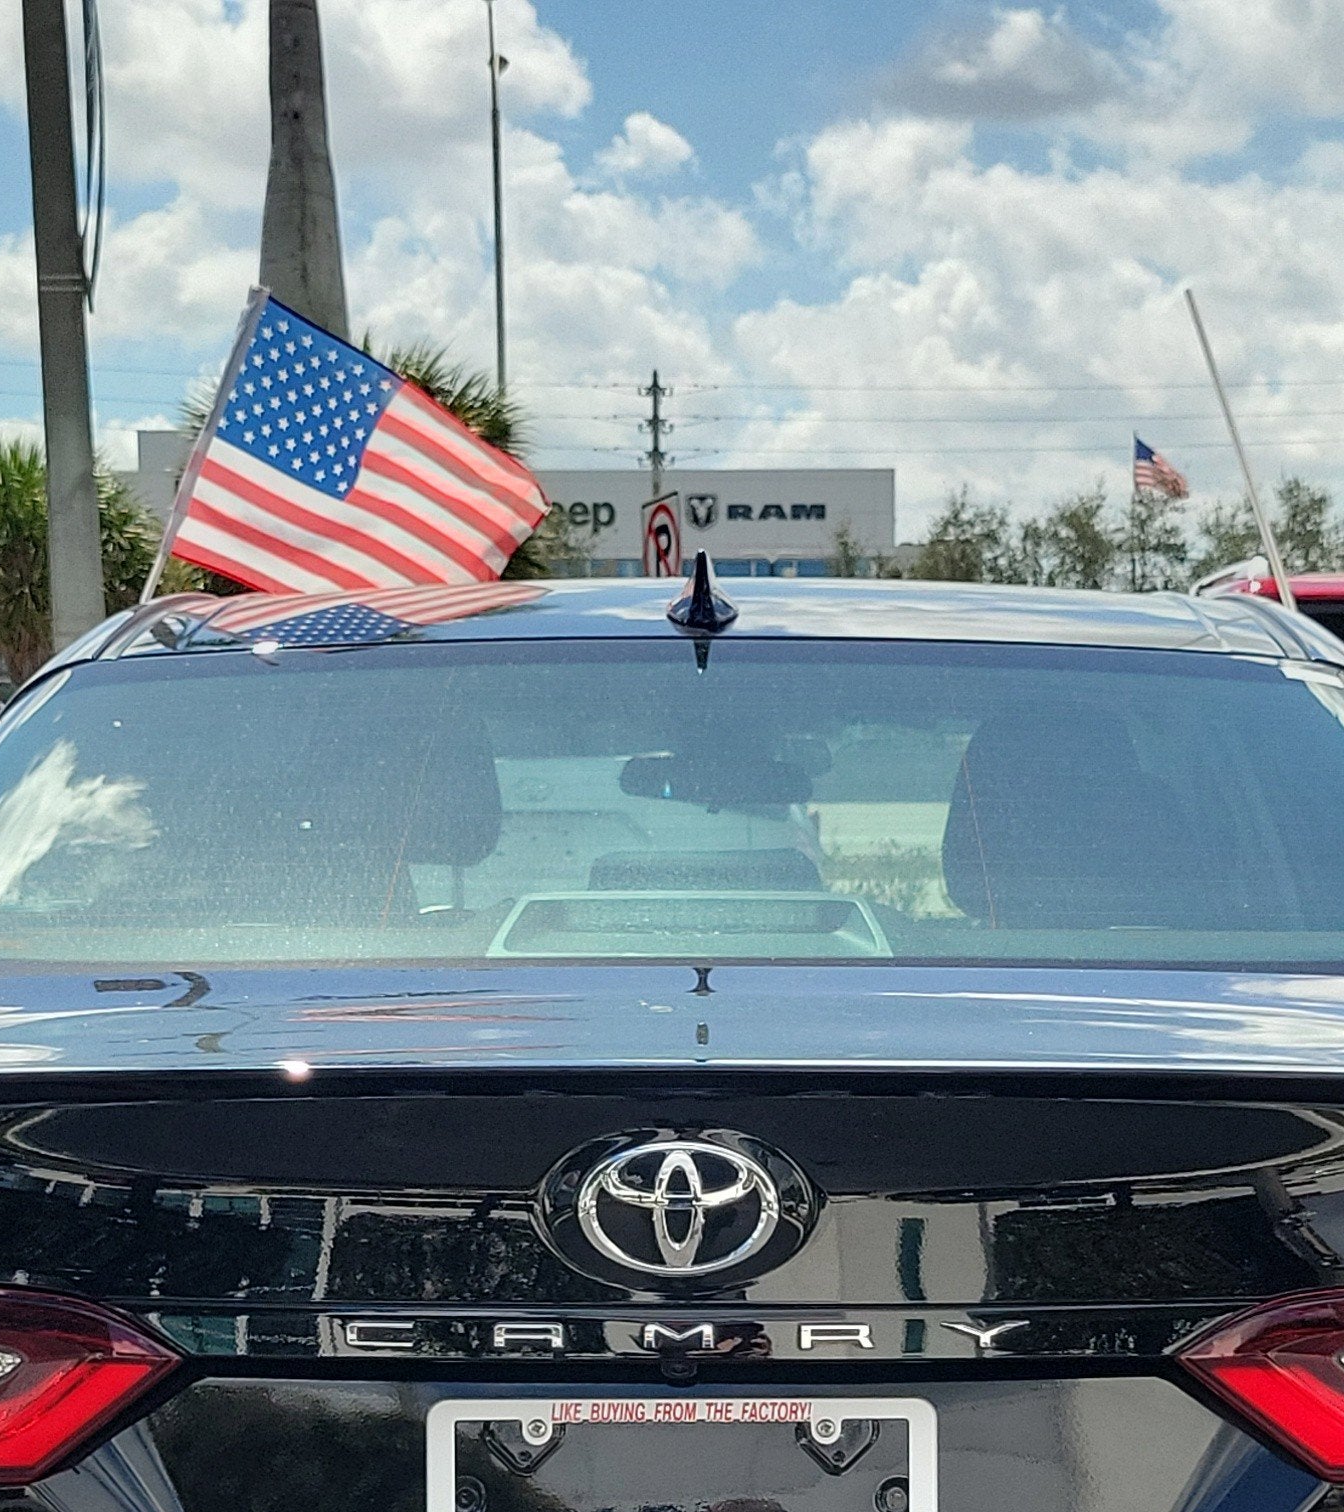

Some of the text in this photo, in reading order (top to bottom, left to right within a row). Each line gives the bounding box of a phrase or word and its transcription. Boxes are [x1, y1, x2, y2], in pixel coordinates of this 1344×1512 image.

[726, 504, 827, 521] RAM
[346, 1319, 1031, 1349] CAMRY
[551, 1402, 812, 1421] LIKE BUYING FROM THE FACTORY!
